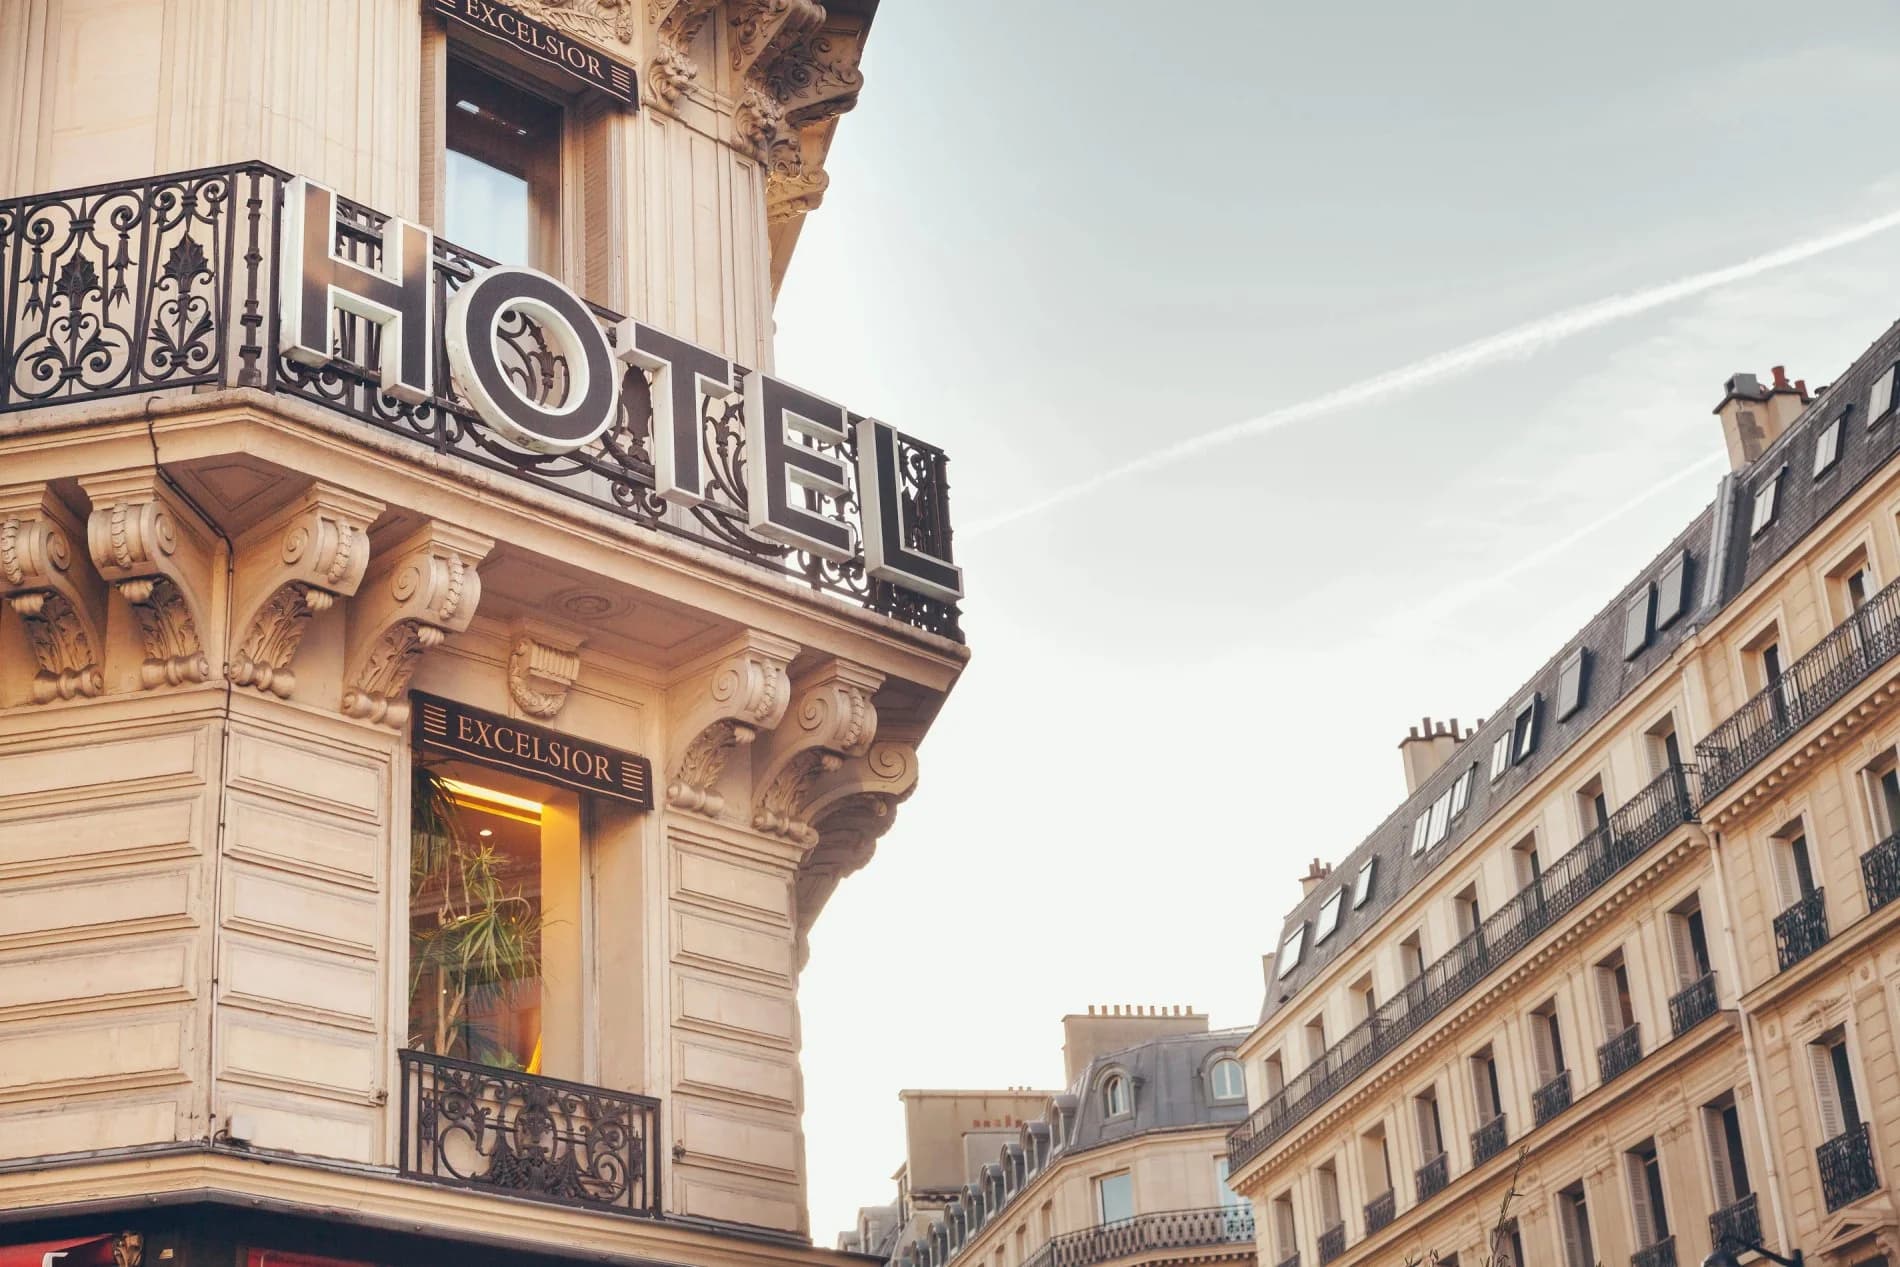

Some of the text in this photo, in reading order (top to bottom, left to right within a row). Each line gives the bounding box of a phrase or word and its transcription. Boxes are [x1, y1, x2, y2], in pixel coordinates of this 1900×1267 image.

[465, 0, 605, 80] EXCELSIOR
[279, 174, 964, 601] HOTEL
[457, 715, 613, 782] EXCELSIOR
